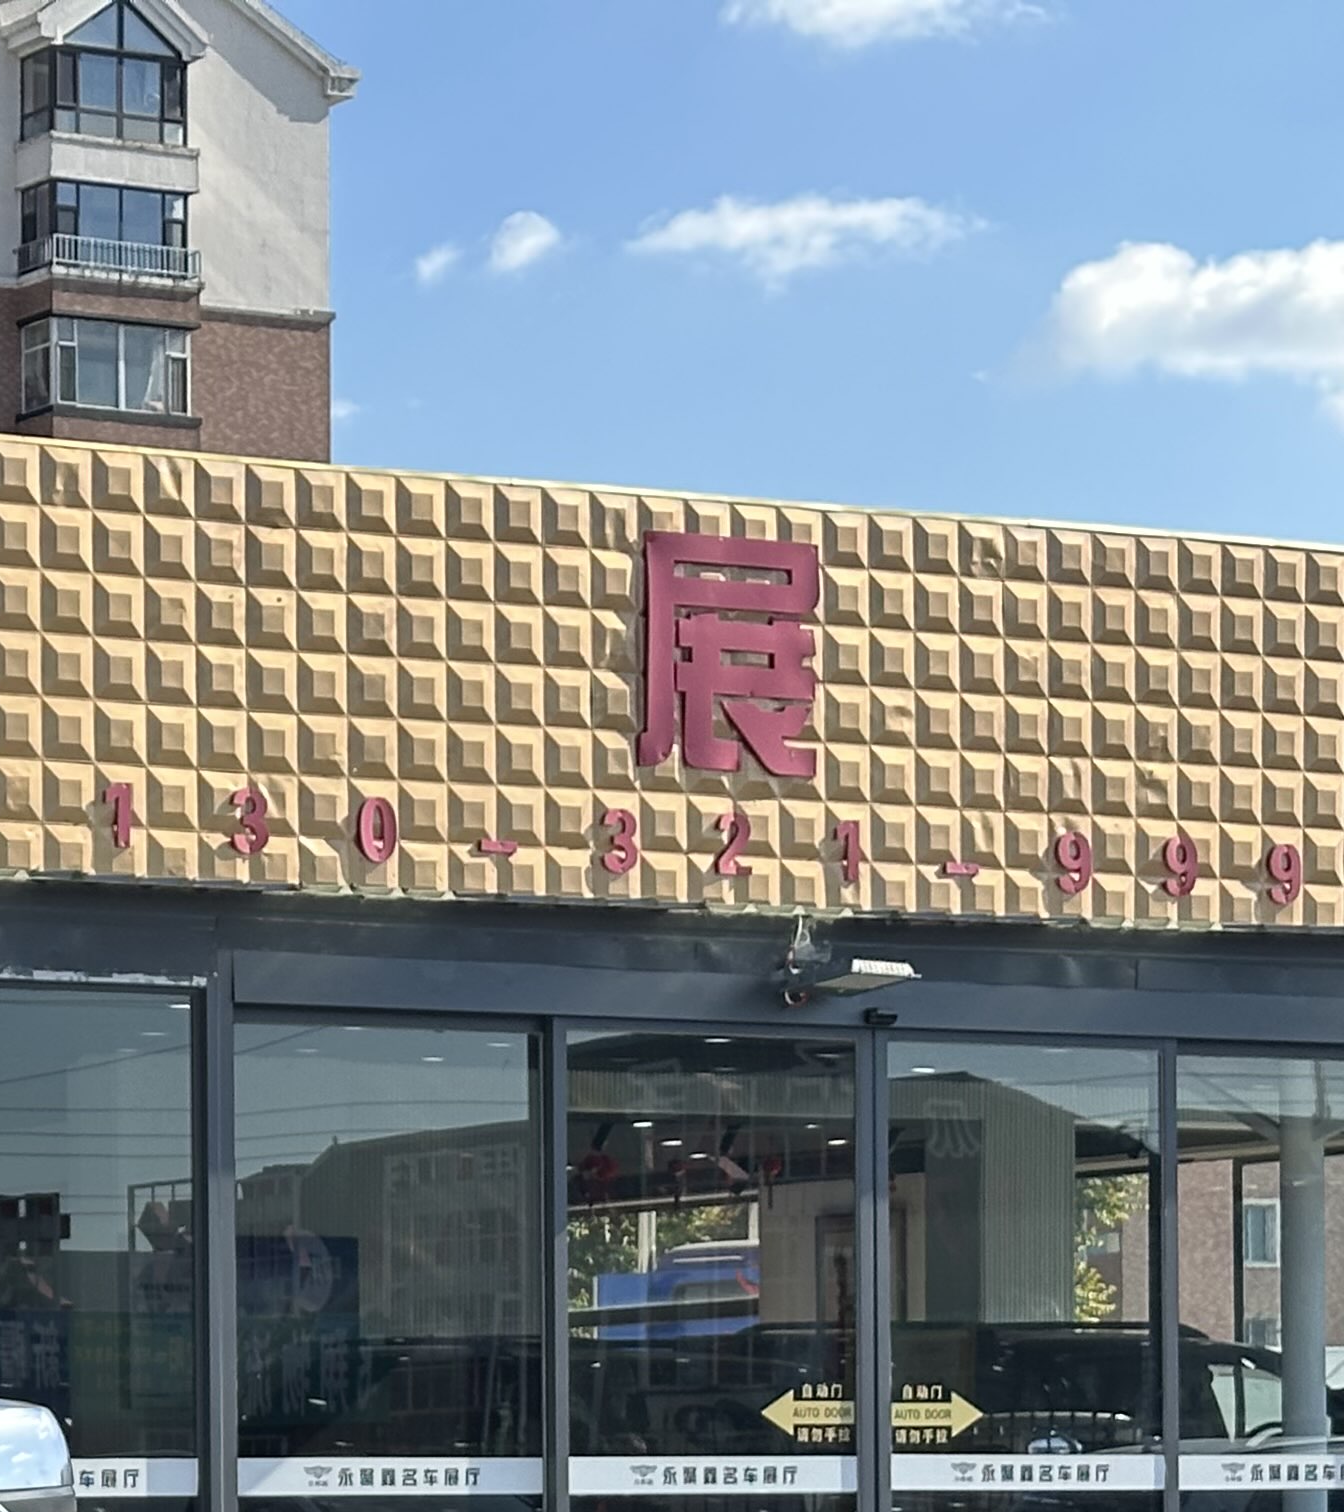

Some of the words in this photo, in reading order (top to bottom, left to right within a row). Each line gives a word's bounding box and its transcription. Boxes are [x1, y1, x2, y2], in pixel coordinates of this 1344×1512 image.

[801, 1383, 843, 1398] 自动门
[902, 1384, 943, 1400] 自动门
[793, 1406, 820, 1419] AUTO
[824, 1406, 853, 1419] DOOR
[894, 1408, 921, 1420] AUTO
[925, 1408, 952, 1420] DOOR
[895, 1429, 949, 1445] 请勿手拉
[1251, 1463, 1344, 1482] 永聚鑫名车
